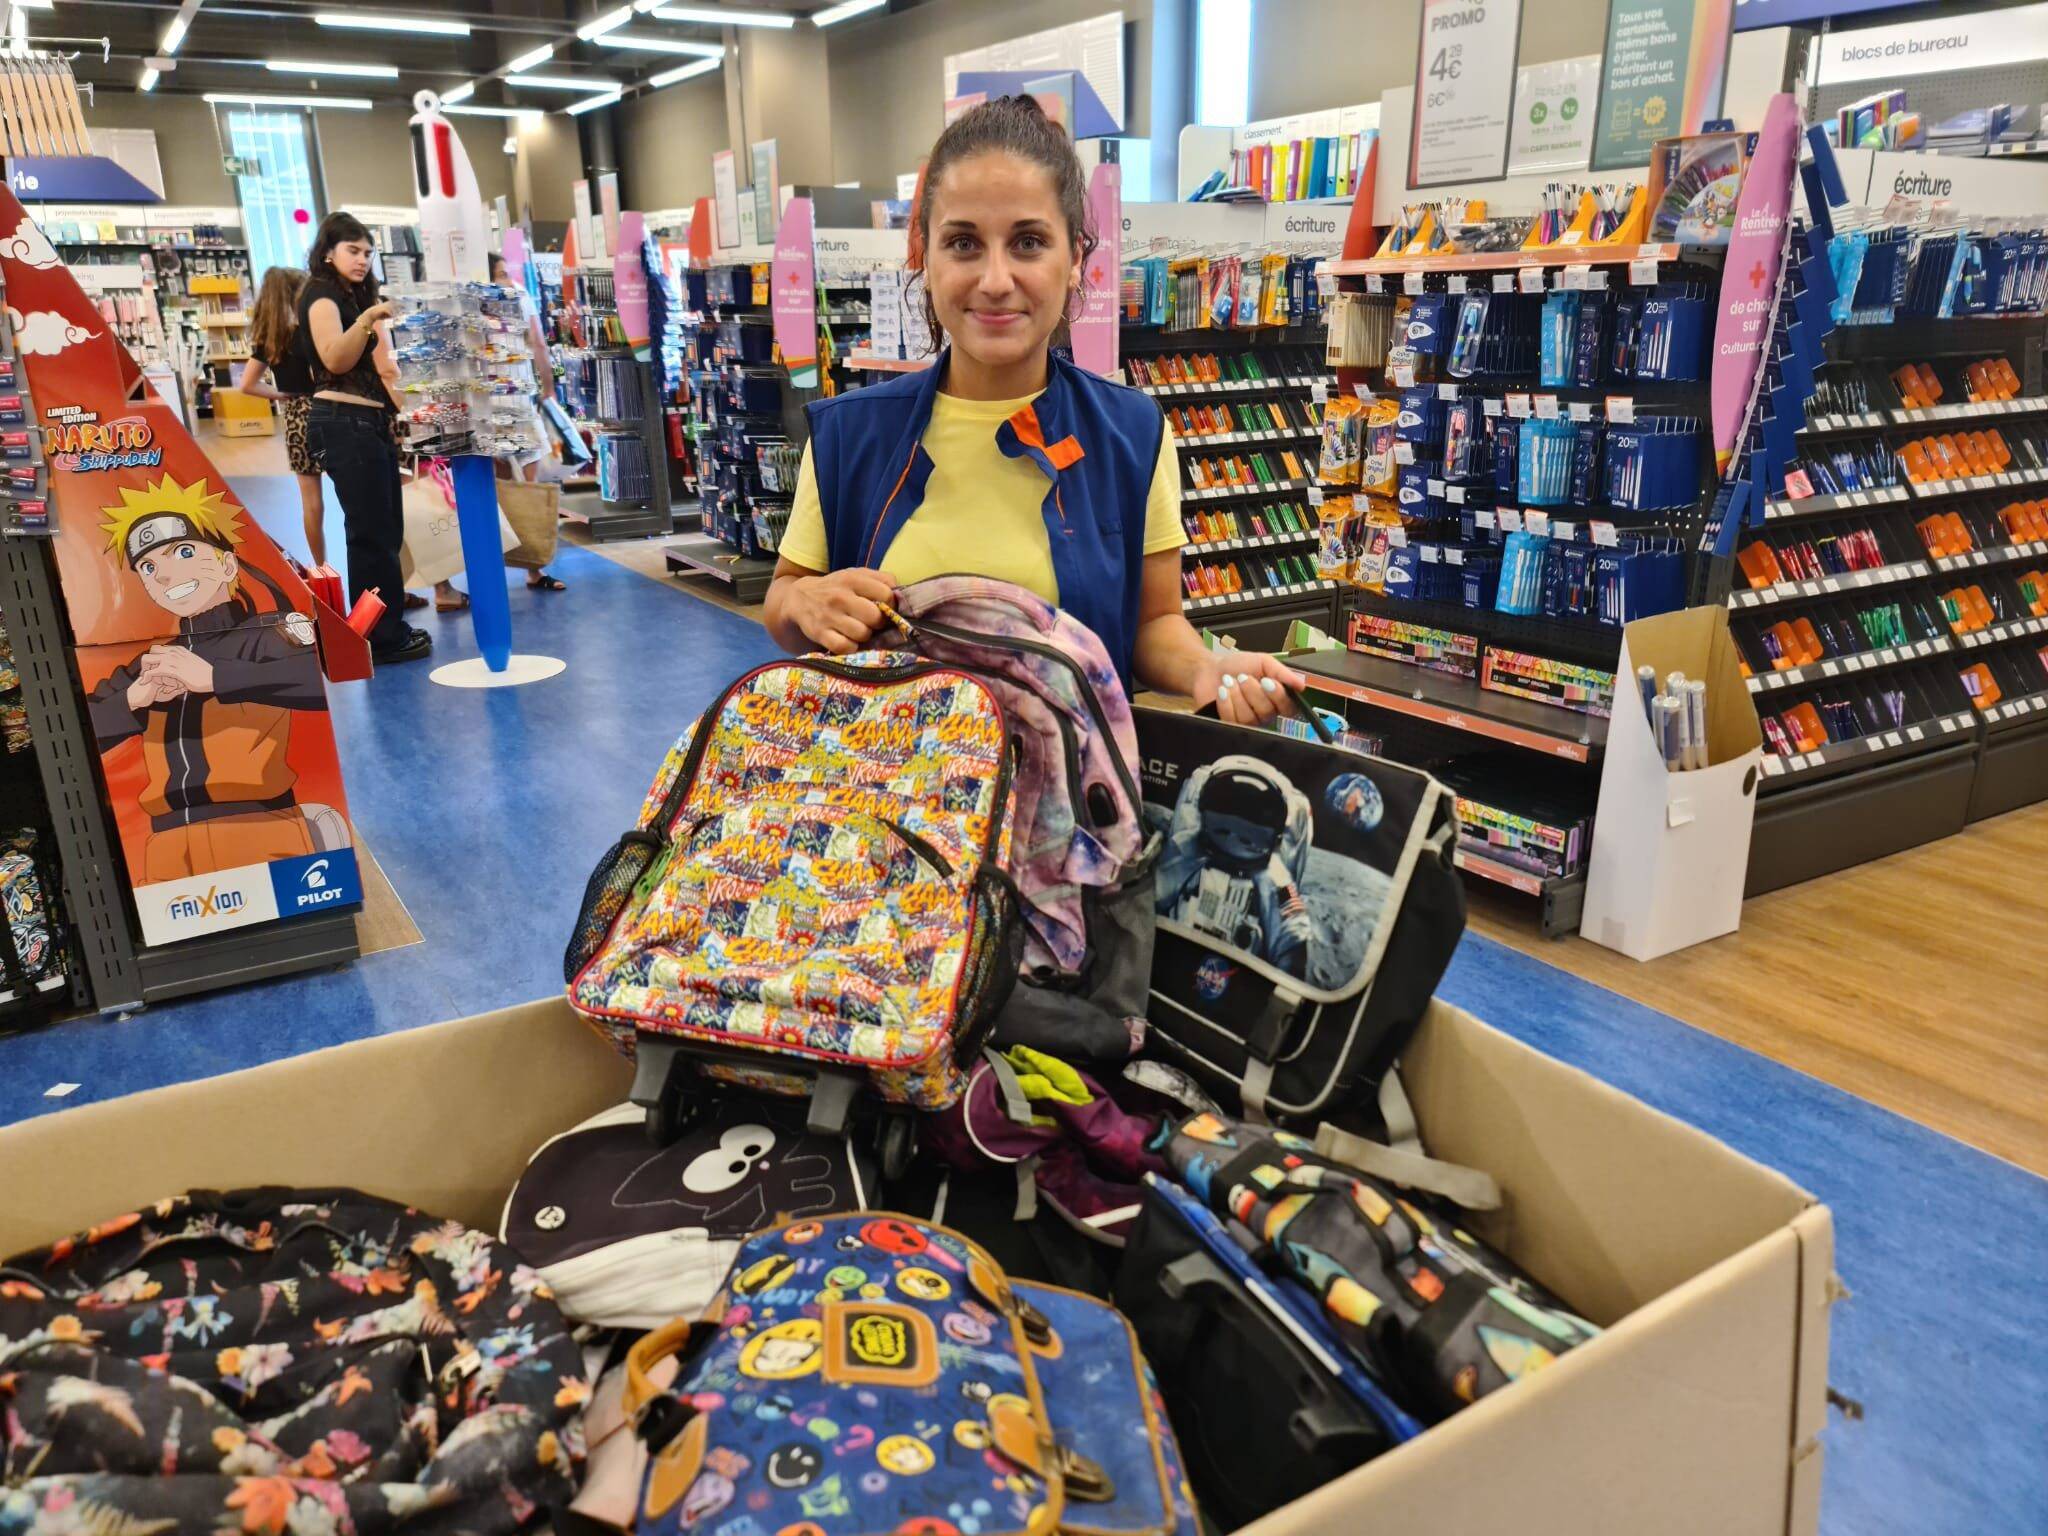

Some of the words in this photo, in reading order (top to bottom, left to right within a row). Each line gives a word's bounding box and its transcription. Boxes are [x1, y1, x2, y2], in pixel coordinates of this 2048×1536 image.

[1431, 8, 1485, 32] PROMO
[1618, 12, 1643, 24] Tous
[1644, 8, 1664, 20] vos
[1616, 21, 1669, 38] cartables,
[1615, 35, 1649, 51] même
[1650, 33, 1677, 46] bons
[1842, 47, 1882, 63] blocs
[1885, 41, 1905, 57] de
[1908, 34, 1969, 54] bureau
[1620, 50, 1648, 67] jeter,
[1611, 59, 1658, 78] méritent
[1659, 59, 1674, 71] un
[1610, 78, 1631, 91] bon
[1631, 72, 1676, 88] d'achat.
[1243, 125, 1283, 141] classement
[1894, 170, 1951, 196] écriture
[1285, 216, 1336, 234] écriture
[1741, 214, 1780, 231] Rentrée
[1416, 308, 1421, 319] 3
[1646, 302, 1659, 314] 20
[1730, 300, 1745, 315] de
[1746, 296, 1772, 313] choi
[1743, 319, 1761, 332] sur
[47, 405, 81, 418] LIMITED
[62, 412, 97, 424] EDITION
[47, 423, 151, 454] NARUTO
[1618, 436, 1630, 448] 20
[72, 447, 162, 473] SHIPPUDEN
[1599, 559, 1611, 570] 20
[298, 887, 343, 907] PILOT
